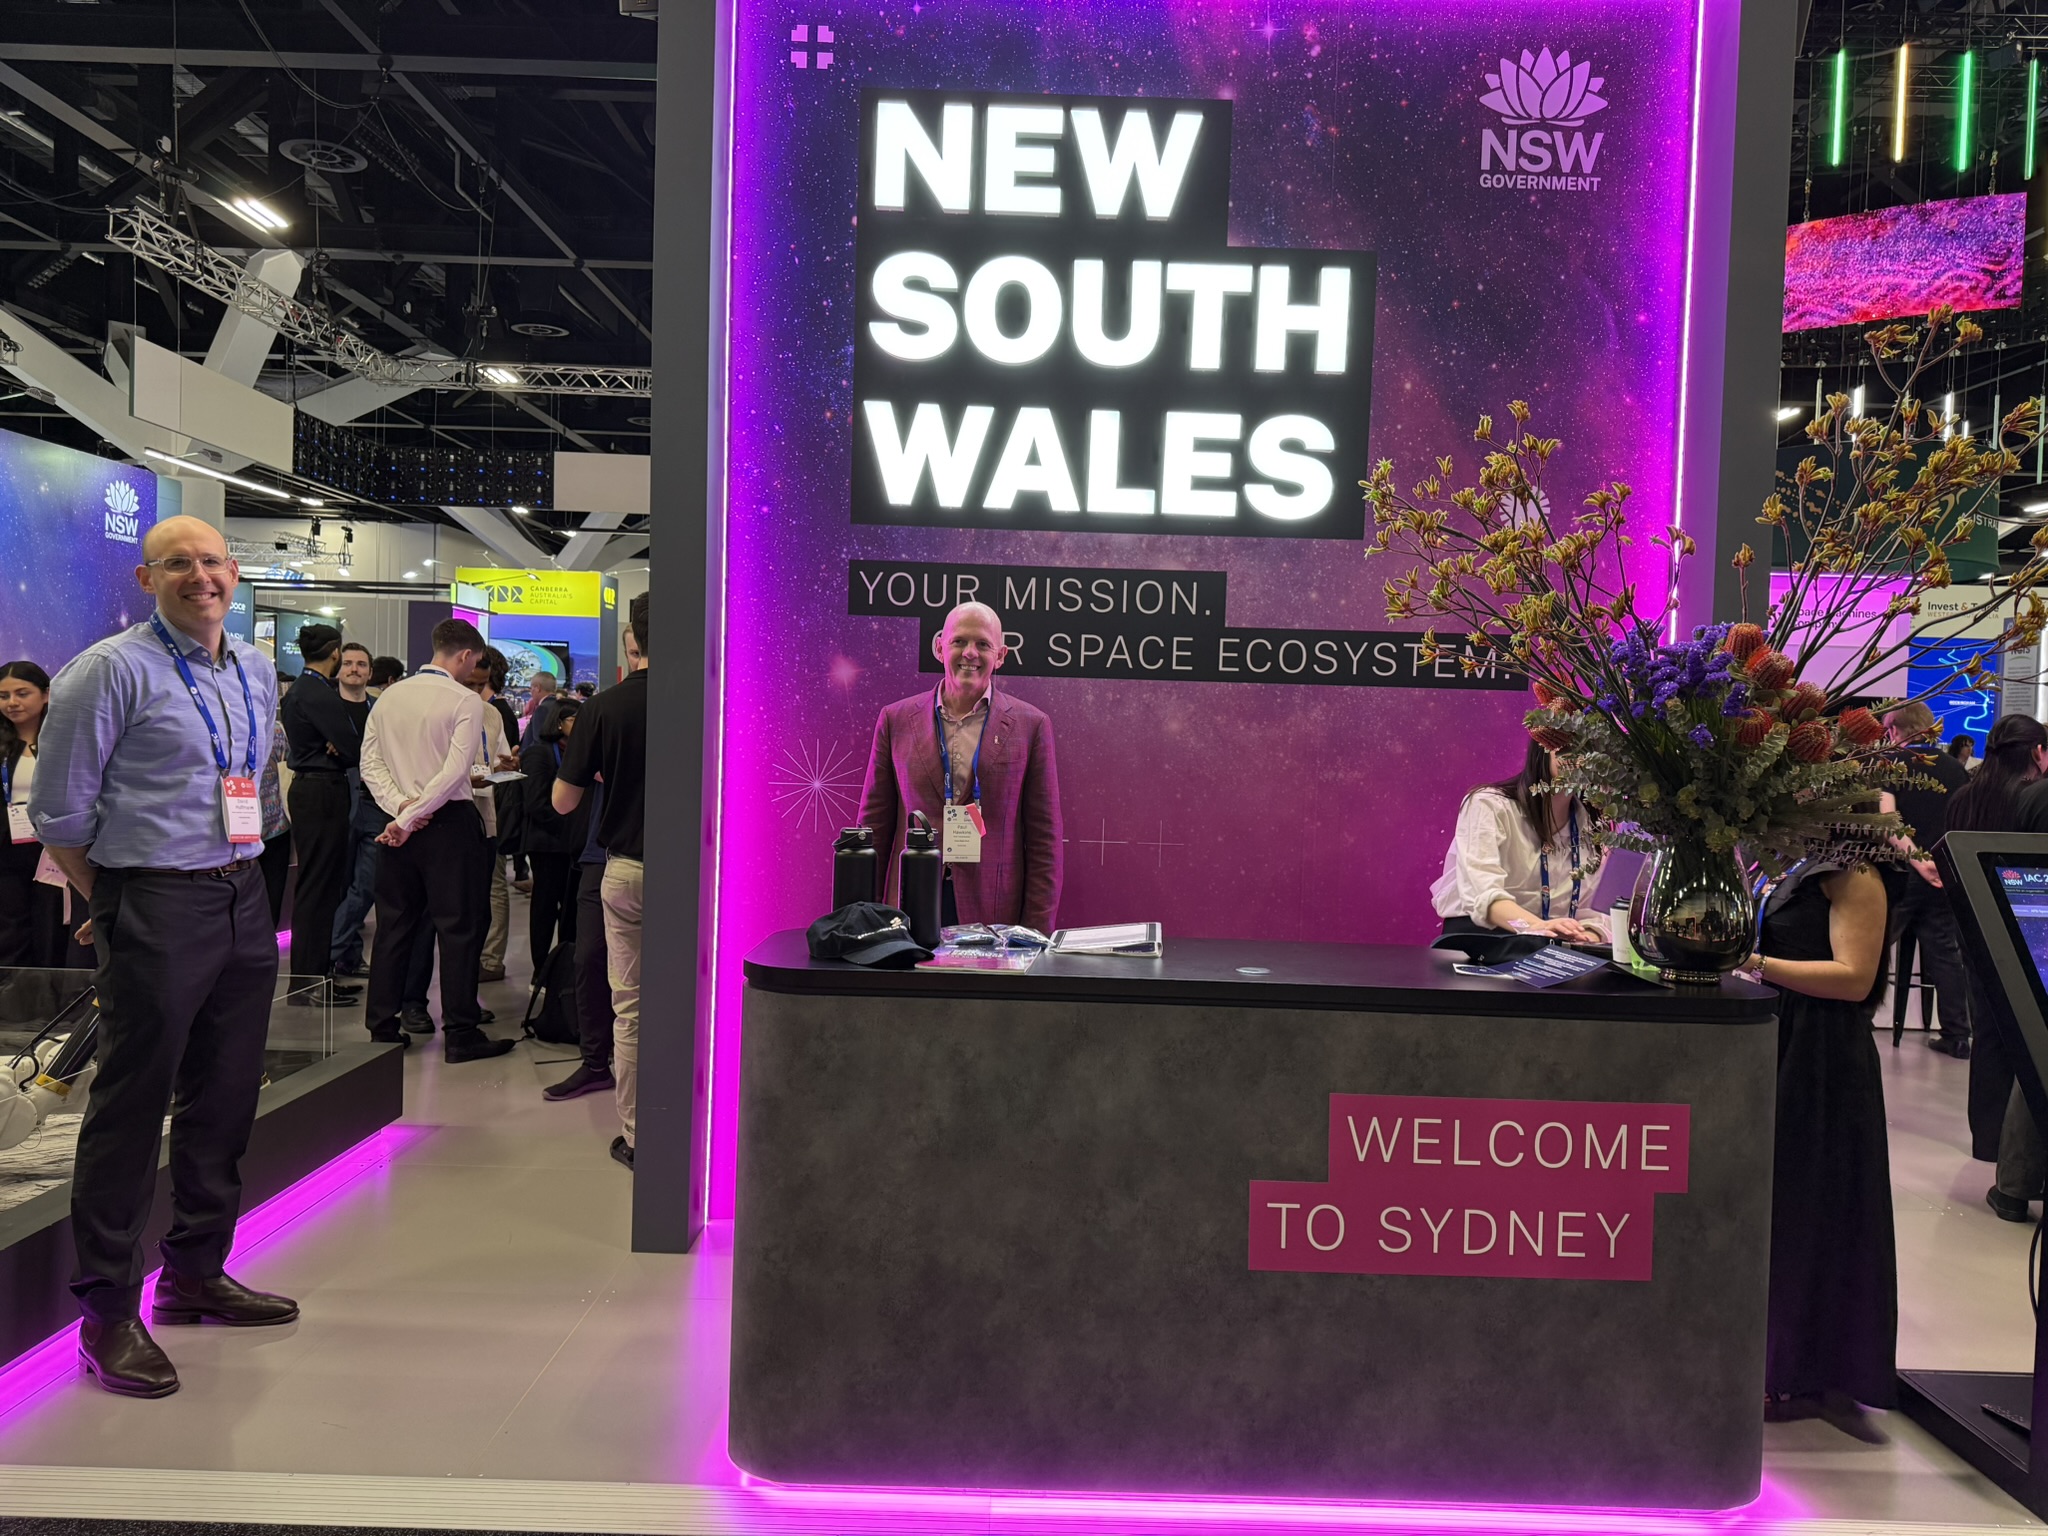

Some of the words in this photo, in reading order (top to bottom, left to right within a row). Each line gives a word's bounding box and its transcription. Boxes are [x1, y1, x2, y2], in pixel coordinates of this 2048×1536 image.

[874, 99, 1204, 220] NEW
[1480, 128, 1605, 174] NSW
[1479, 173, 1602, 192] GOVERNMENT
[868, 250, 1352, 374] SOUTH
[862, 399, 1336, 521] WALES
[105, 512, 139, 537] NSW
[105, 531, 139, 545] GOVERNMENT
[859, 571, 980, 608] YOUR
[1005, 575, 1213, 616] MISSION.
[1927, 601, 1959, 611] Invest
[1961, 602, 1968, 611] &
[1047, 632, 1194, 672] SPACE
[1217, 636, 1511, 680] ECOSYSTEM.
[2023, 873, 2042, 883] IAC
[1347, 1115, 1671, 1171] WELCOME
[1267, 1202, 1346, 1252] TO
[1378, 1206, 1631, 1259] SYDNEY
